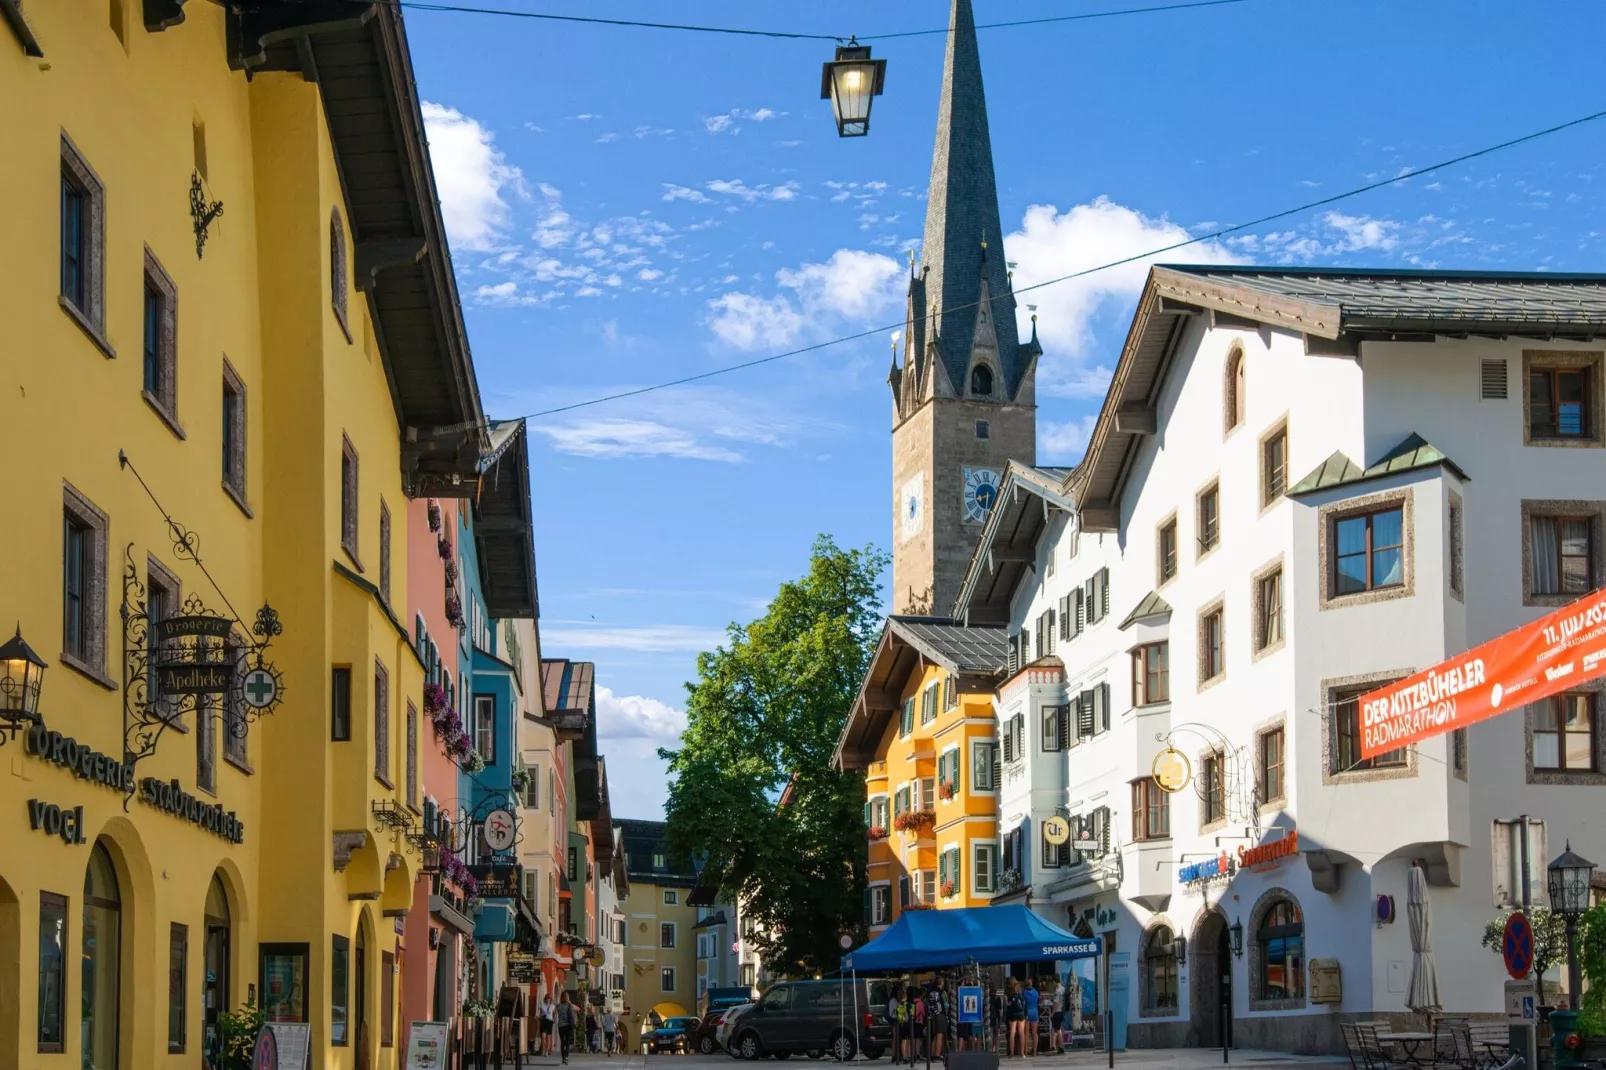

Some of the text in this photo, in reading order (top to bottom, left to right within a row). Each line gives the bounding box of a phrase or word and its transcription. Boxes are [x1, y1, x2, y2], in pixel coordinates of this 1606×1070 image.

[165, 620, 224, 634] Drogerie
[1543, 626, 1559, 645] 11.
[166, 667, 226, 690] Apotheke
[1363, 659, 1486, 727] DER KITZBÜHELER
[1365, 697, 1456, 749] RADMARATHON
[28, 716, 134, 793] DROGERIE
[28, 799, 87, 844] VOGL
[1042, 944, 1088, 955] SPARKASSE
